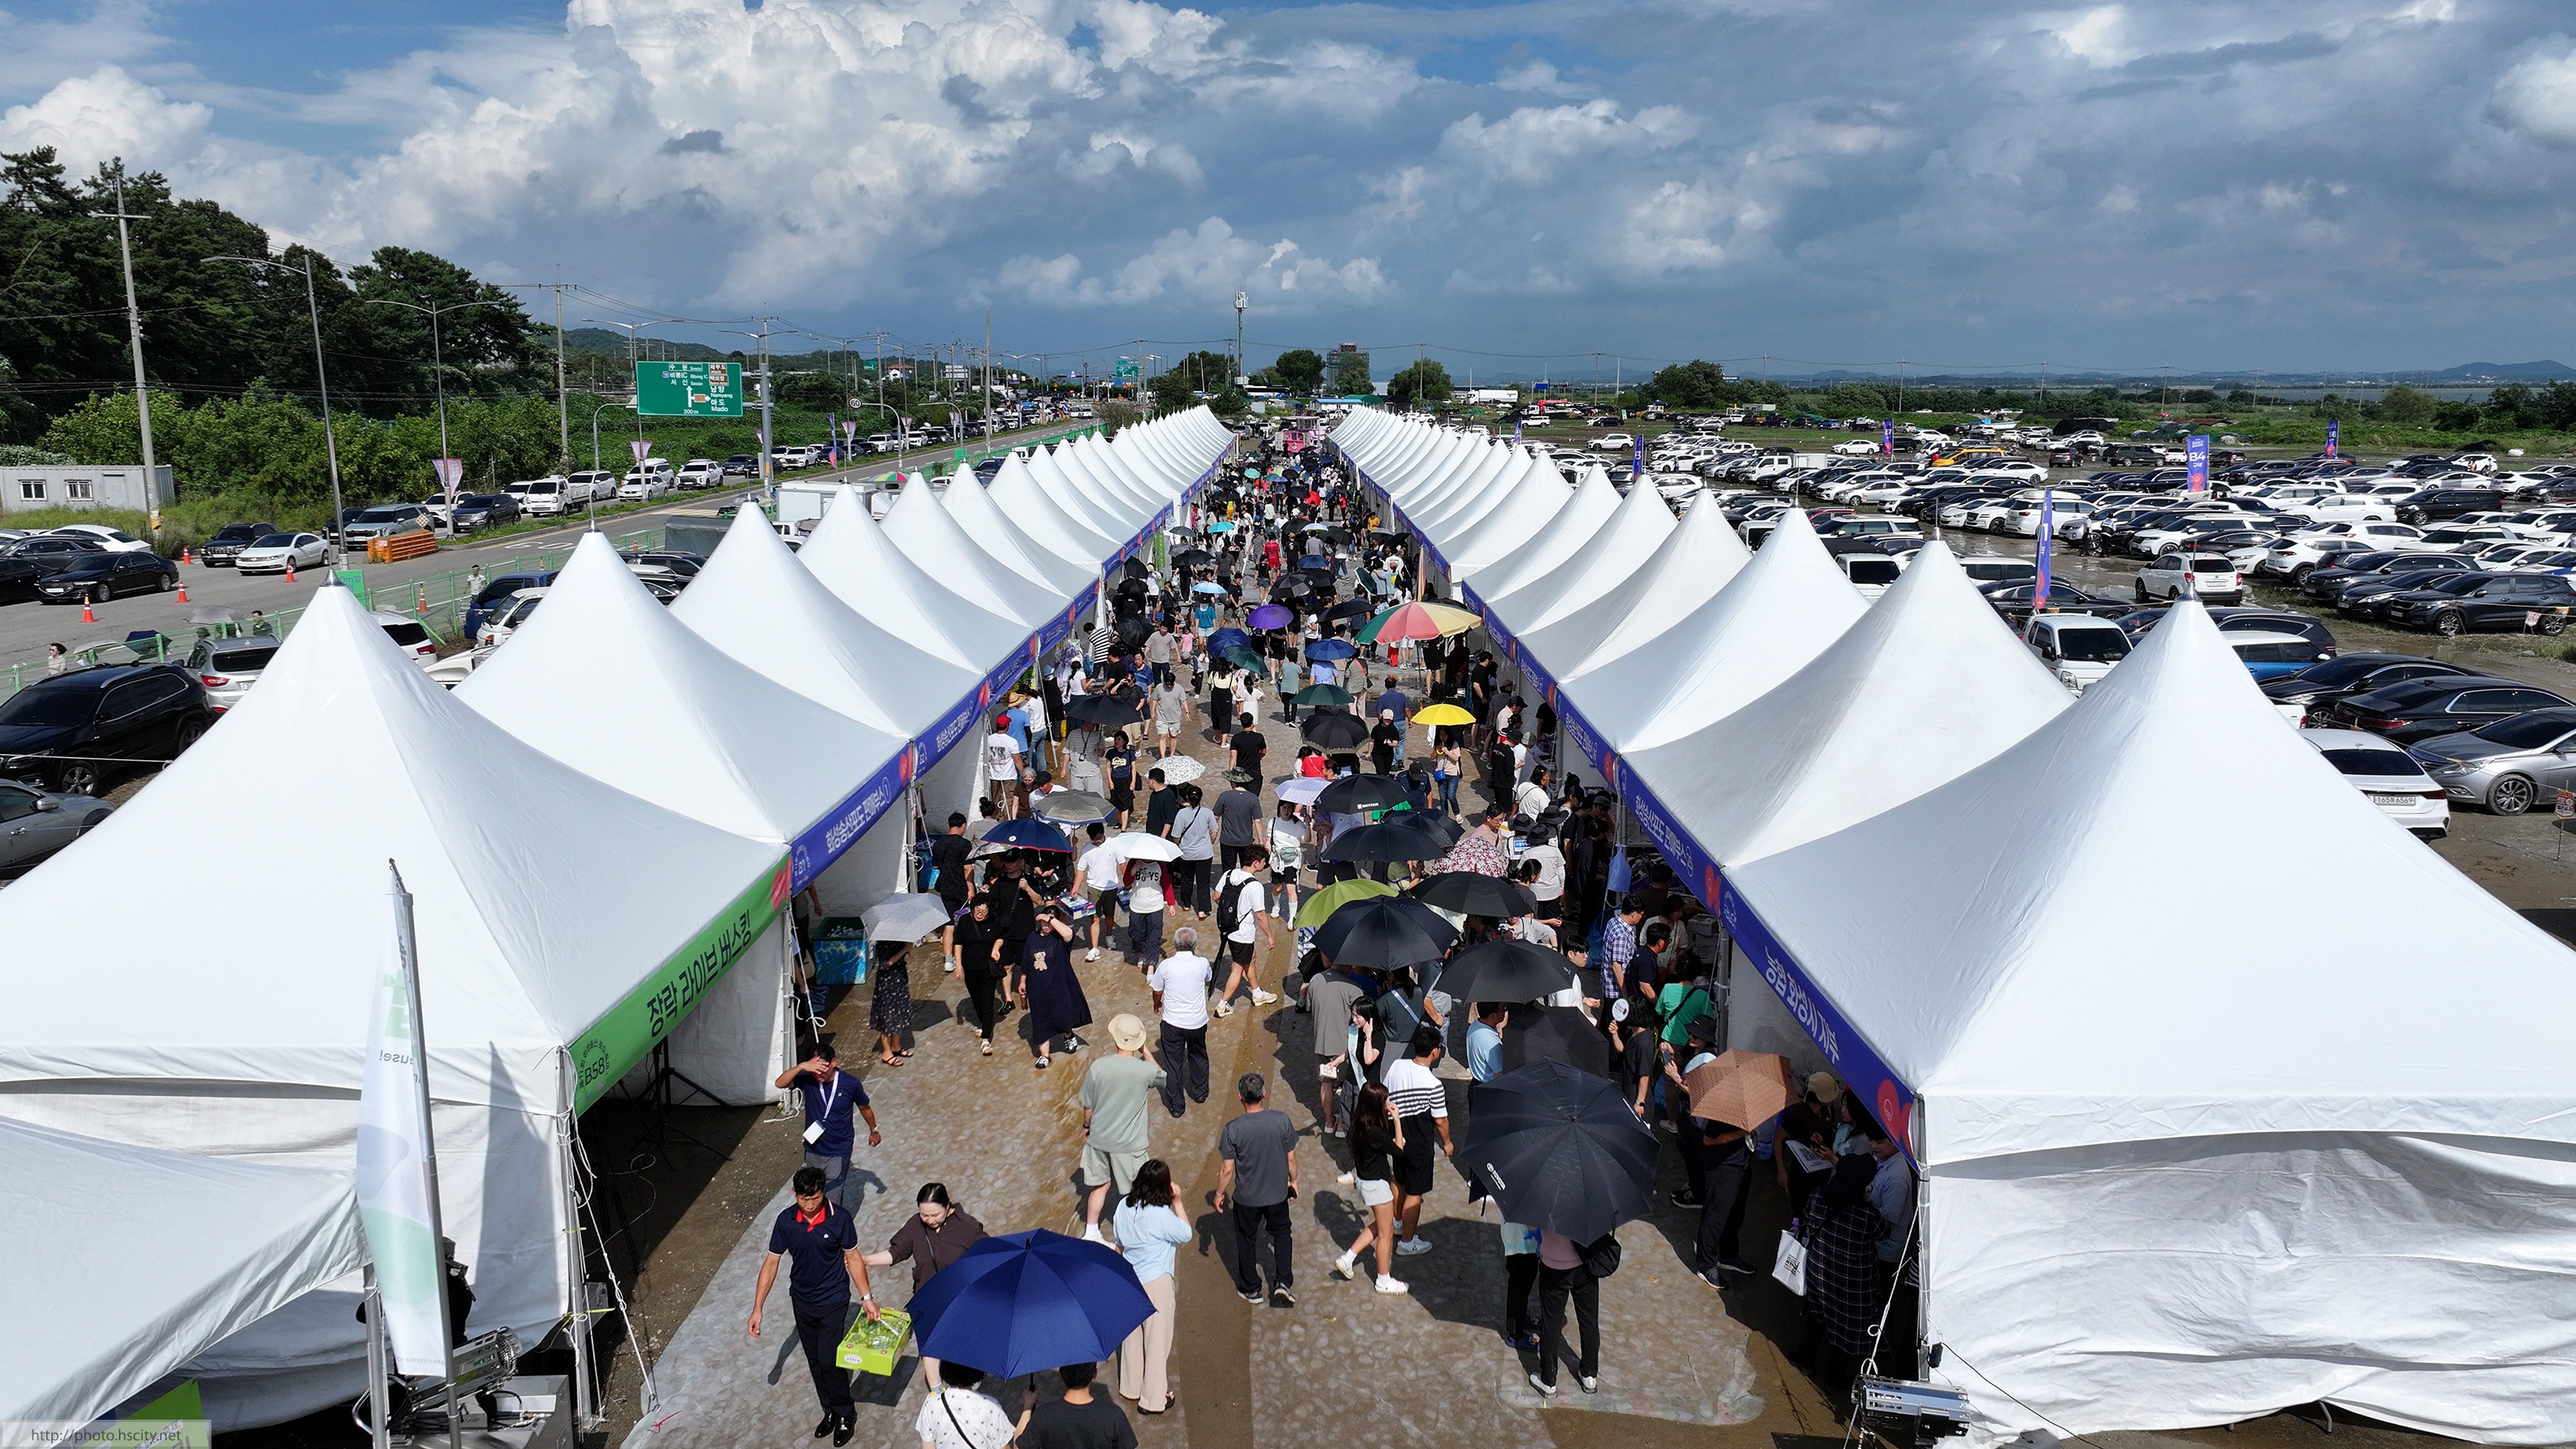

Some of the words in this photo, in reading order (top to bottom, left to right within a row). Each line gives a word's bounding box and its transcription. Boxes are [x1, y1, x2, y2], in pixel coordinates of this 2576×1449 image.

[2189, 451, 2206, 462] B4
[646, 981, 678, 1038] 장락
[679, 943, 719, 1009] 라이브
[719, 909, 751, 969] 버스킹
[585, 1057, 605, 1086] B58
